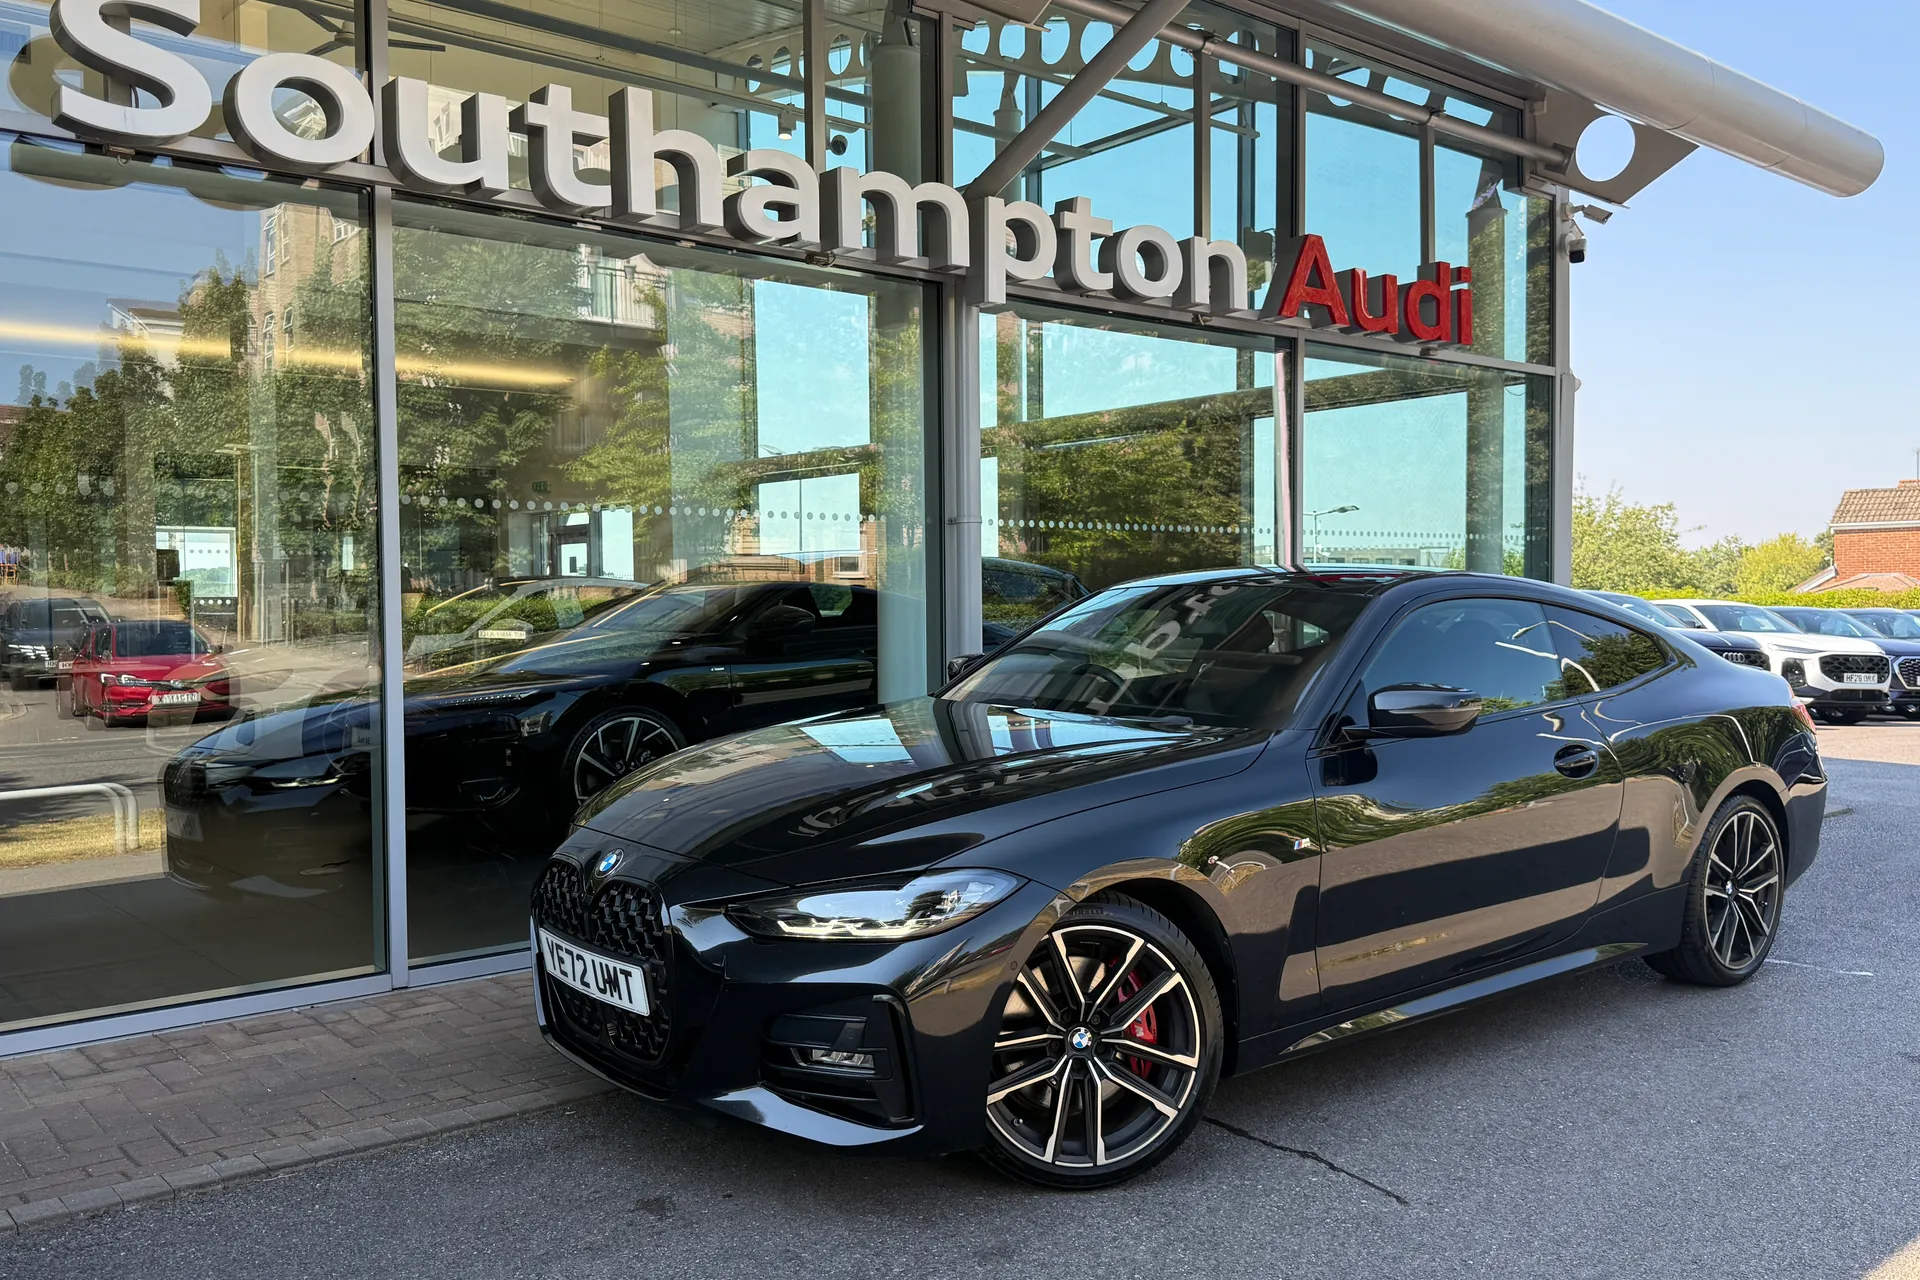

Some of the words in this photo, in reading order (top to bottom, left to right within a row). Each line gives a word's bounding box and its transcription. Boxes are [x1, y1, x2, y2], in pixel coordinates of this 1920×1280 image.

[51, 0, 1248, 306] Southampton
[1272, 233, 1473, 346] Audi
[545, 936, 591, 989] YE72
[592, 959, 633, 1005] UMT
